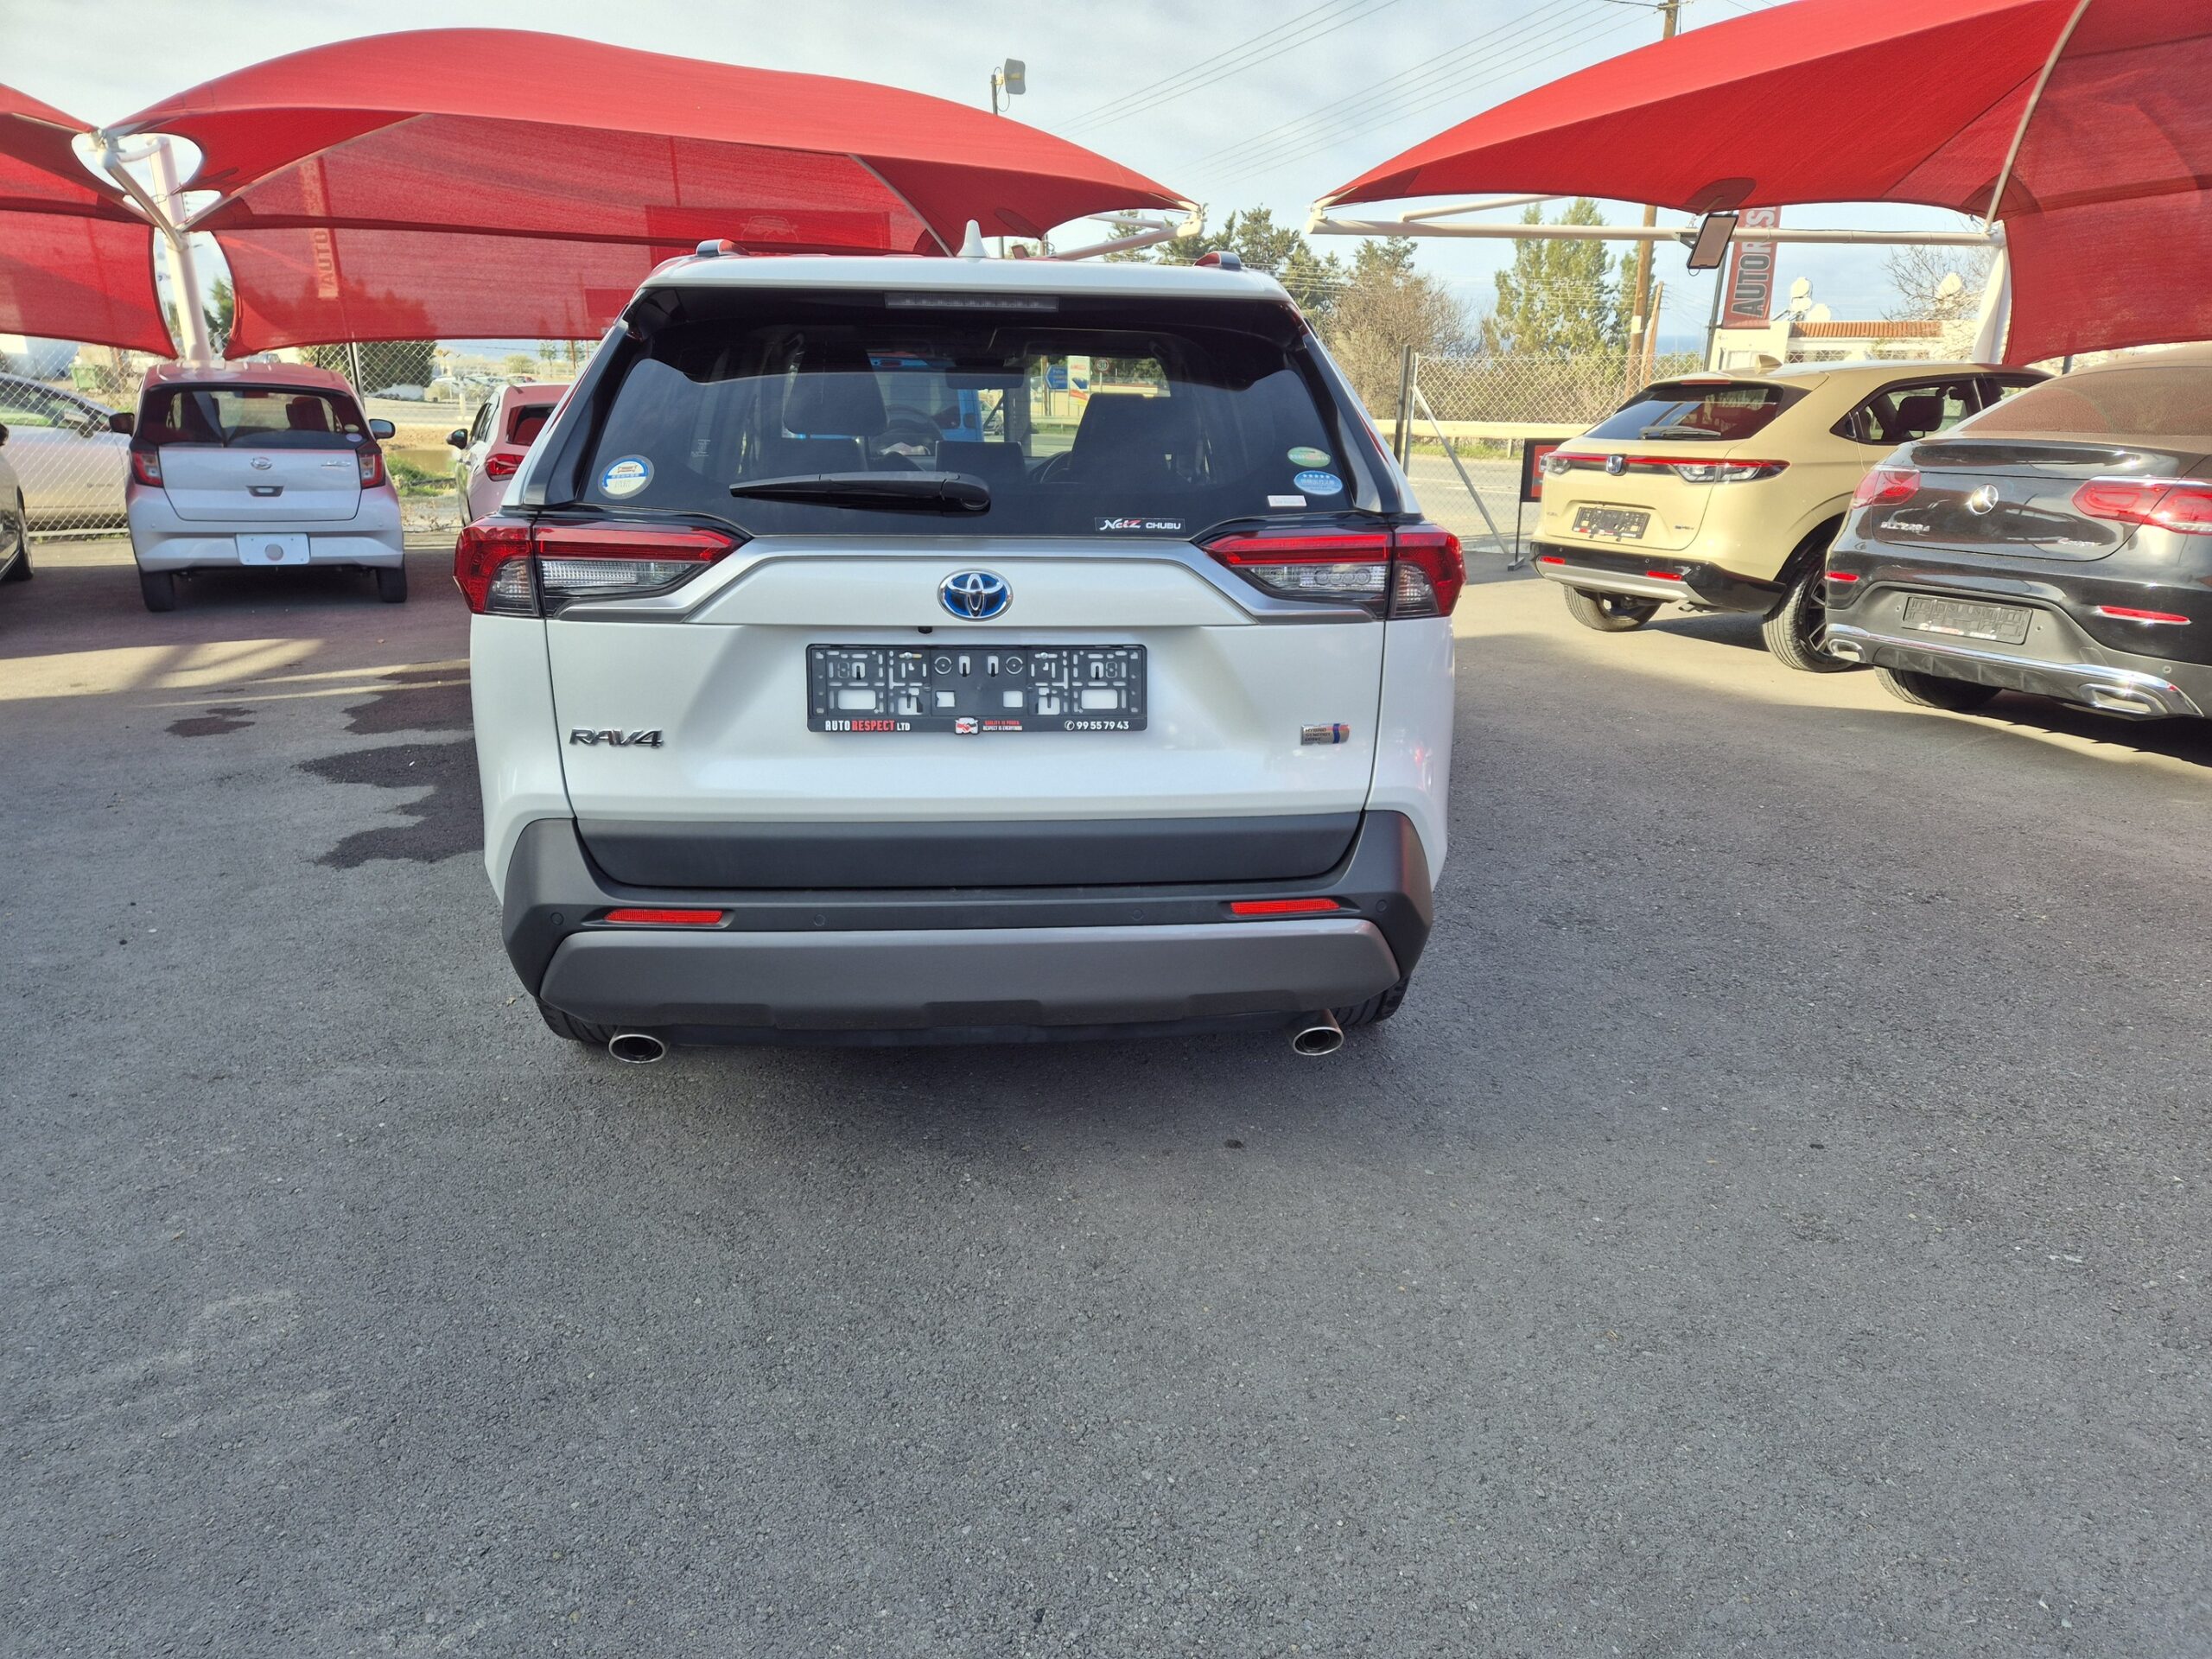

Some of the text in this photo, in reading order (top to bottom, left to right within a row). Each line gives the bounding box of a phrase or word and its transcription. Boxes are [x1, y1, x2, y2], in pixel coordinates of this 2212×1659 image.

[1731, 207, 1776, 318] AUTORS
[1099, 518, 1141, 531] Netz
[896, 722, 911, 731] LTD
[569, 728, 664, 748] RAV4
